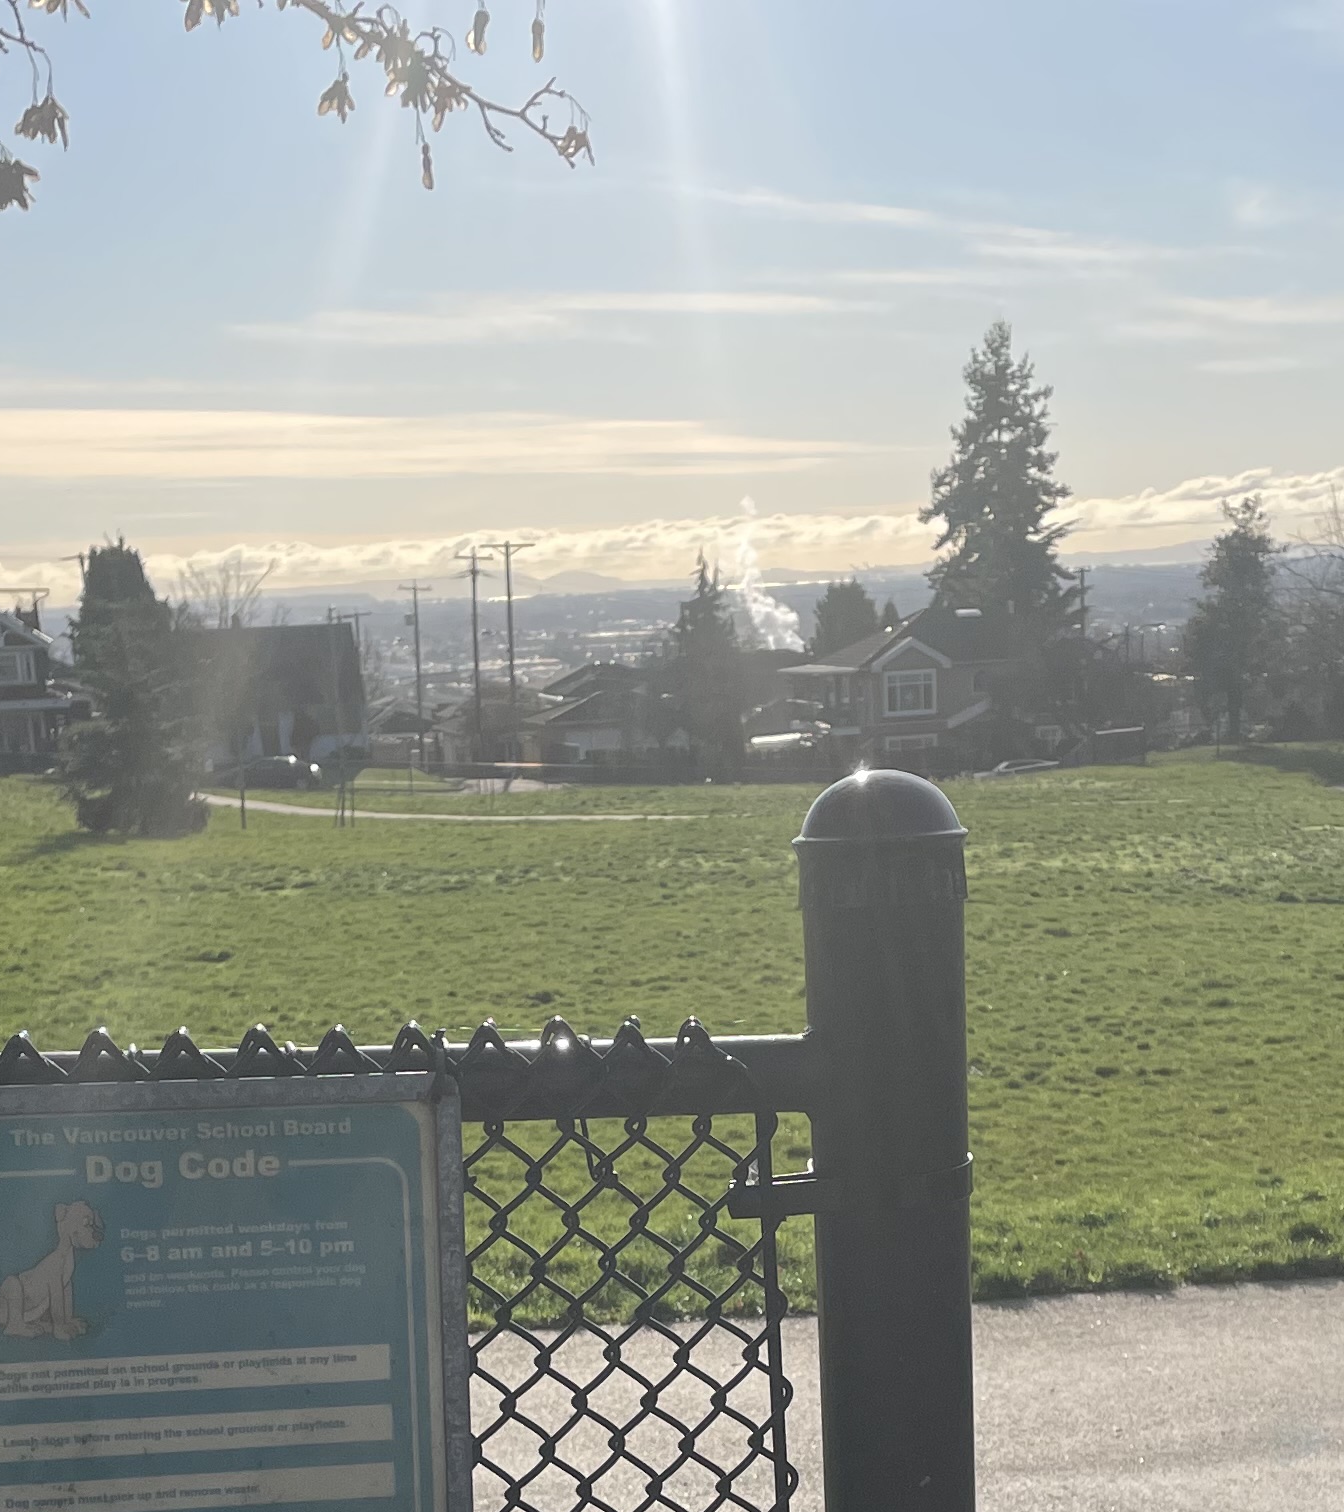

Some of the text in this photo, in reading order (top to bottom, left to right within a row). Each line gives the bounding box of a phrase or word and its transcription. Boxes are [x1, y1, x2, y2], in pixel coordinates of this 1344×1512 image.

[9, 1117, 353, 1147] The Vancouver School Board
[86, 1150, 280, 1188] Dog Code
[120, 1219, 348, 1241] Dogs permitted weekdays from
[167, 1245, 204, 1261] am
[211, 1241, 253, 1259] and
[319, 1240, 356, 1258] pm
[230, 1266, 270, 1279] Please
[272, 1264, 313, 1277] control
[315, 1264, 341, 1276] your
[344, 1262, 366, 1275] dog
[148, 1282, 185, 1295] follow
[187, 1281, 209, 1293] this
[271, 1276, 336, 1290] responsible
[339, 1274, 363, 1288] dog
[30, 1370, 50, 1380] not
[54, 1366, 108, 1380] permitted
[112, 1367, 127, 1376] on
[130, 1363, 169, 1375] school
[172, 1360, 219, 1374] grounds
[223, 1360, 235, 1370] or
[238, 1357, 292, 1371] playfields
[296, 1356, 307, 1366] at
[309, 1355, 329, 1367] any
[333, 1353, 358, 1364] time
[31, 1380, 89, 1395] organized
[93, 1378, 116, 1391] play
[120, 1378, 131, 1388] is
[134, 1377, 144, 1387] in
[3, 1436, 38, 1448] Leash
[41, 1434, 70, 1448] dogs
[74, 1432, 110, 1445] before
[113, 1429, 161, 1443] entering
[163, 1428, 182, 1439] the
[185, 1426, 223, 1438] school
[227, 1423, 273, 1437] grounds
[277, 1423, 288, 1433] or
[5, 1498, 29, 1510] Dog
[33, 1496, 75, 1508] owners
[78, 1494, 108, 1505] must
[109, 1491, 134, 1505] pick
[137, 1491, 152, 1503] up
[156, 1488, 177, 1500] and
[179, 1486, 221, 1498] remove
